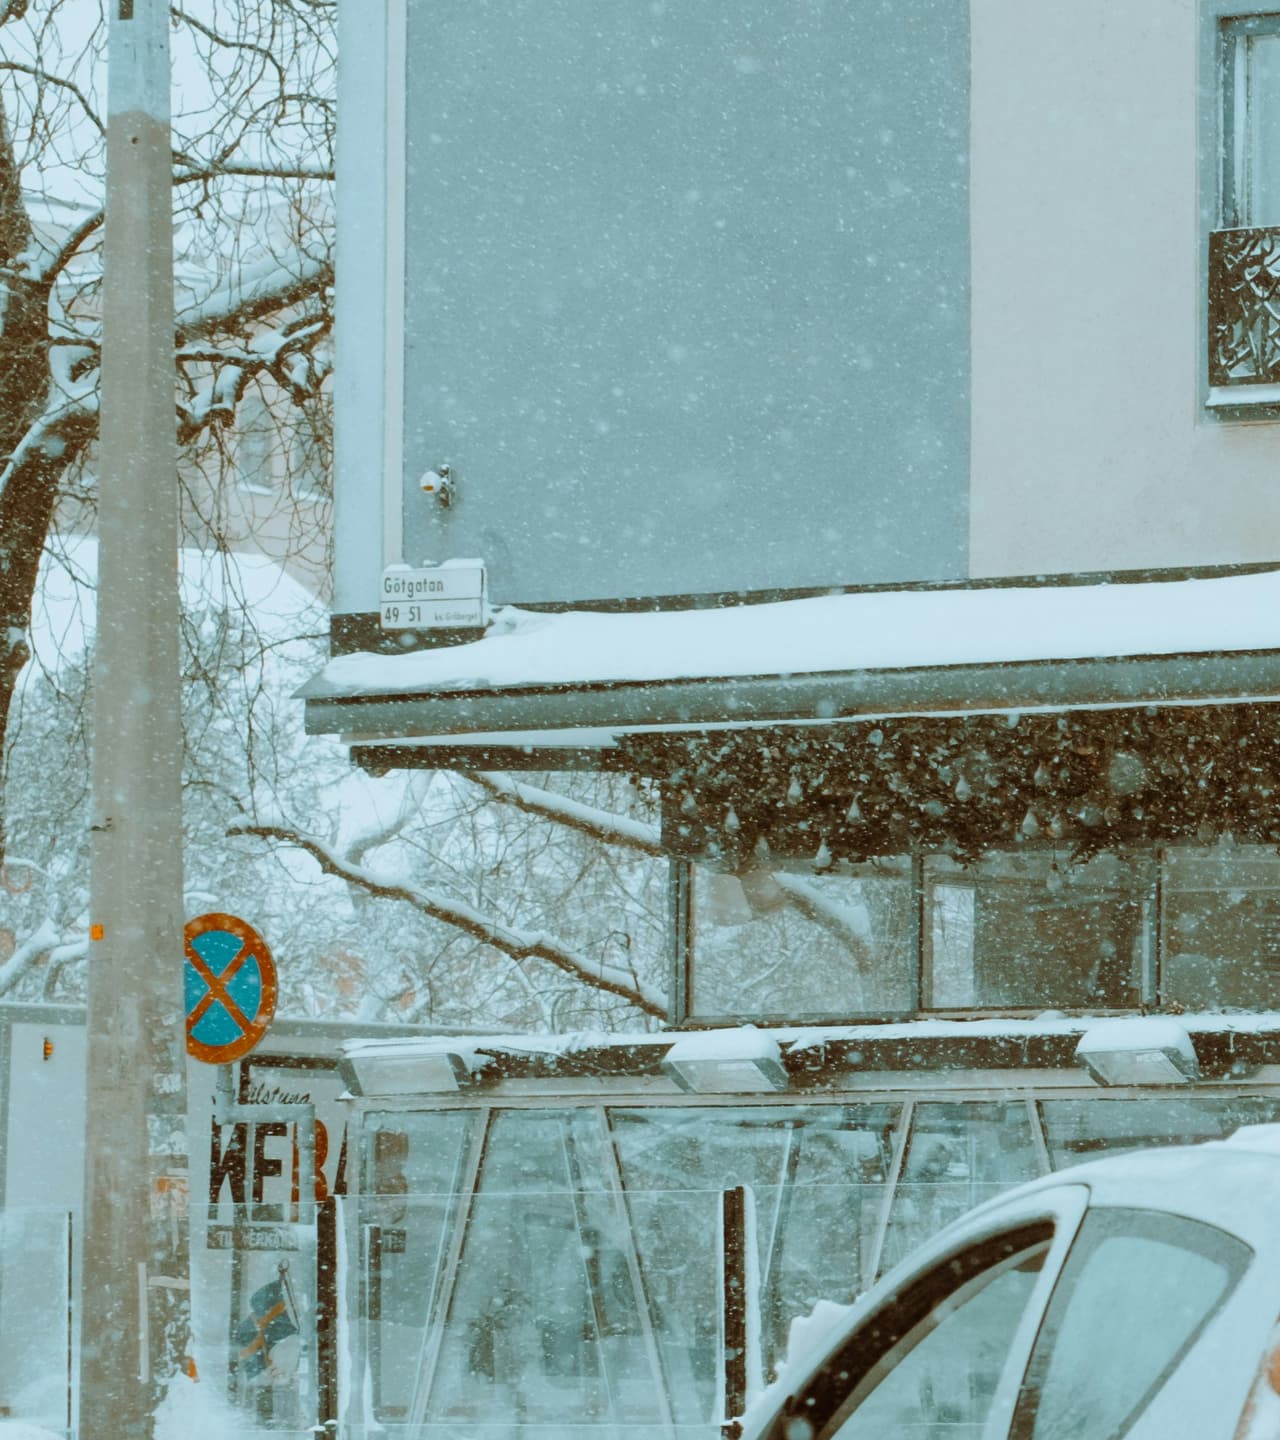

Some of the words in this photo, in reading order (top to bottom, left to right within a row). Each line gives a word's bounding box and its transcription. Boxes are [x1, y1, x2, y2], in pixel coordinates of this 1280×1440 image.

[384, 576, 444, 598] Götgatan
[384, 607, 400, 622] 49
[408, 605, 421, 622] 51
